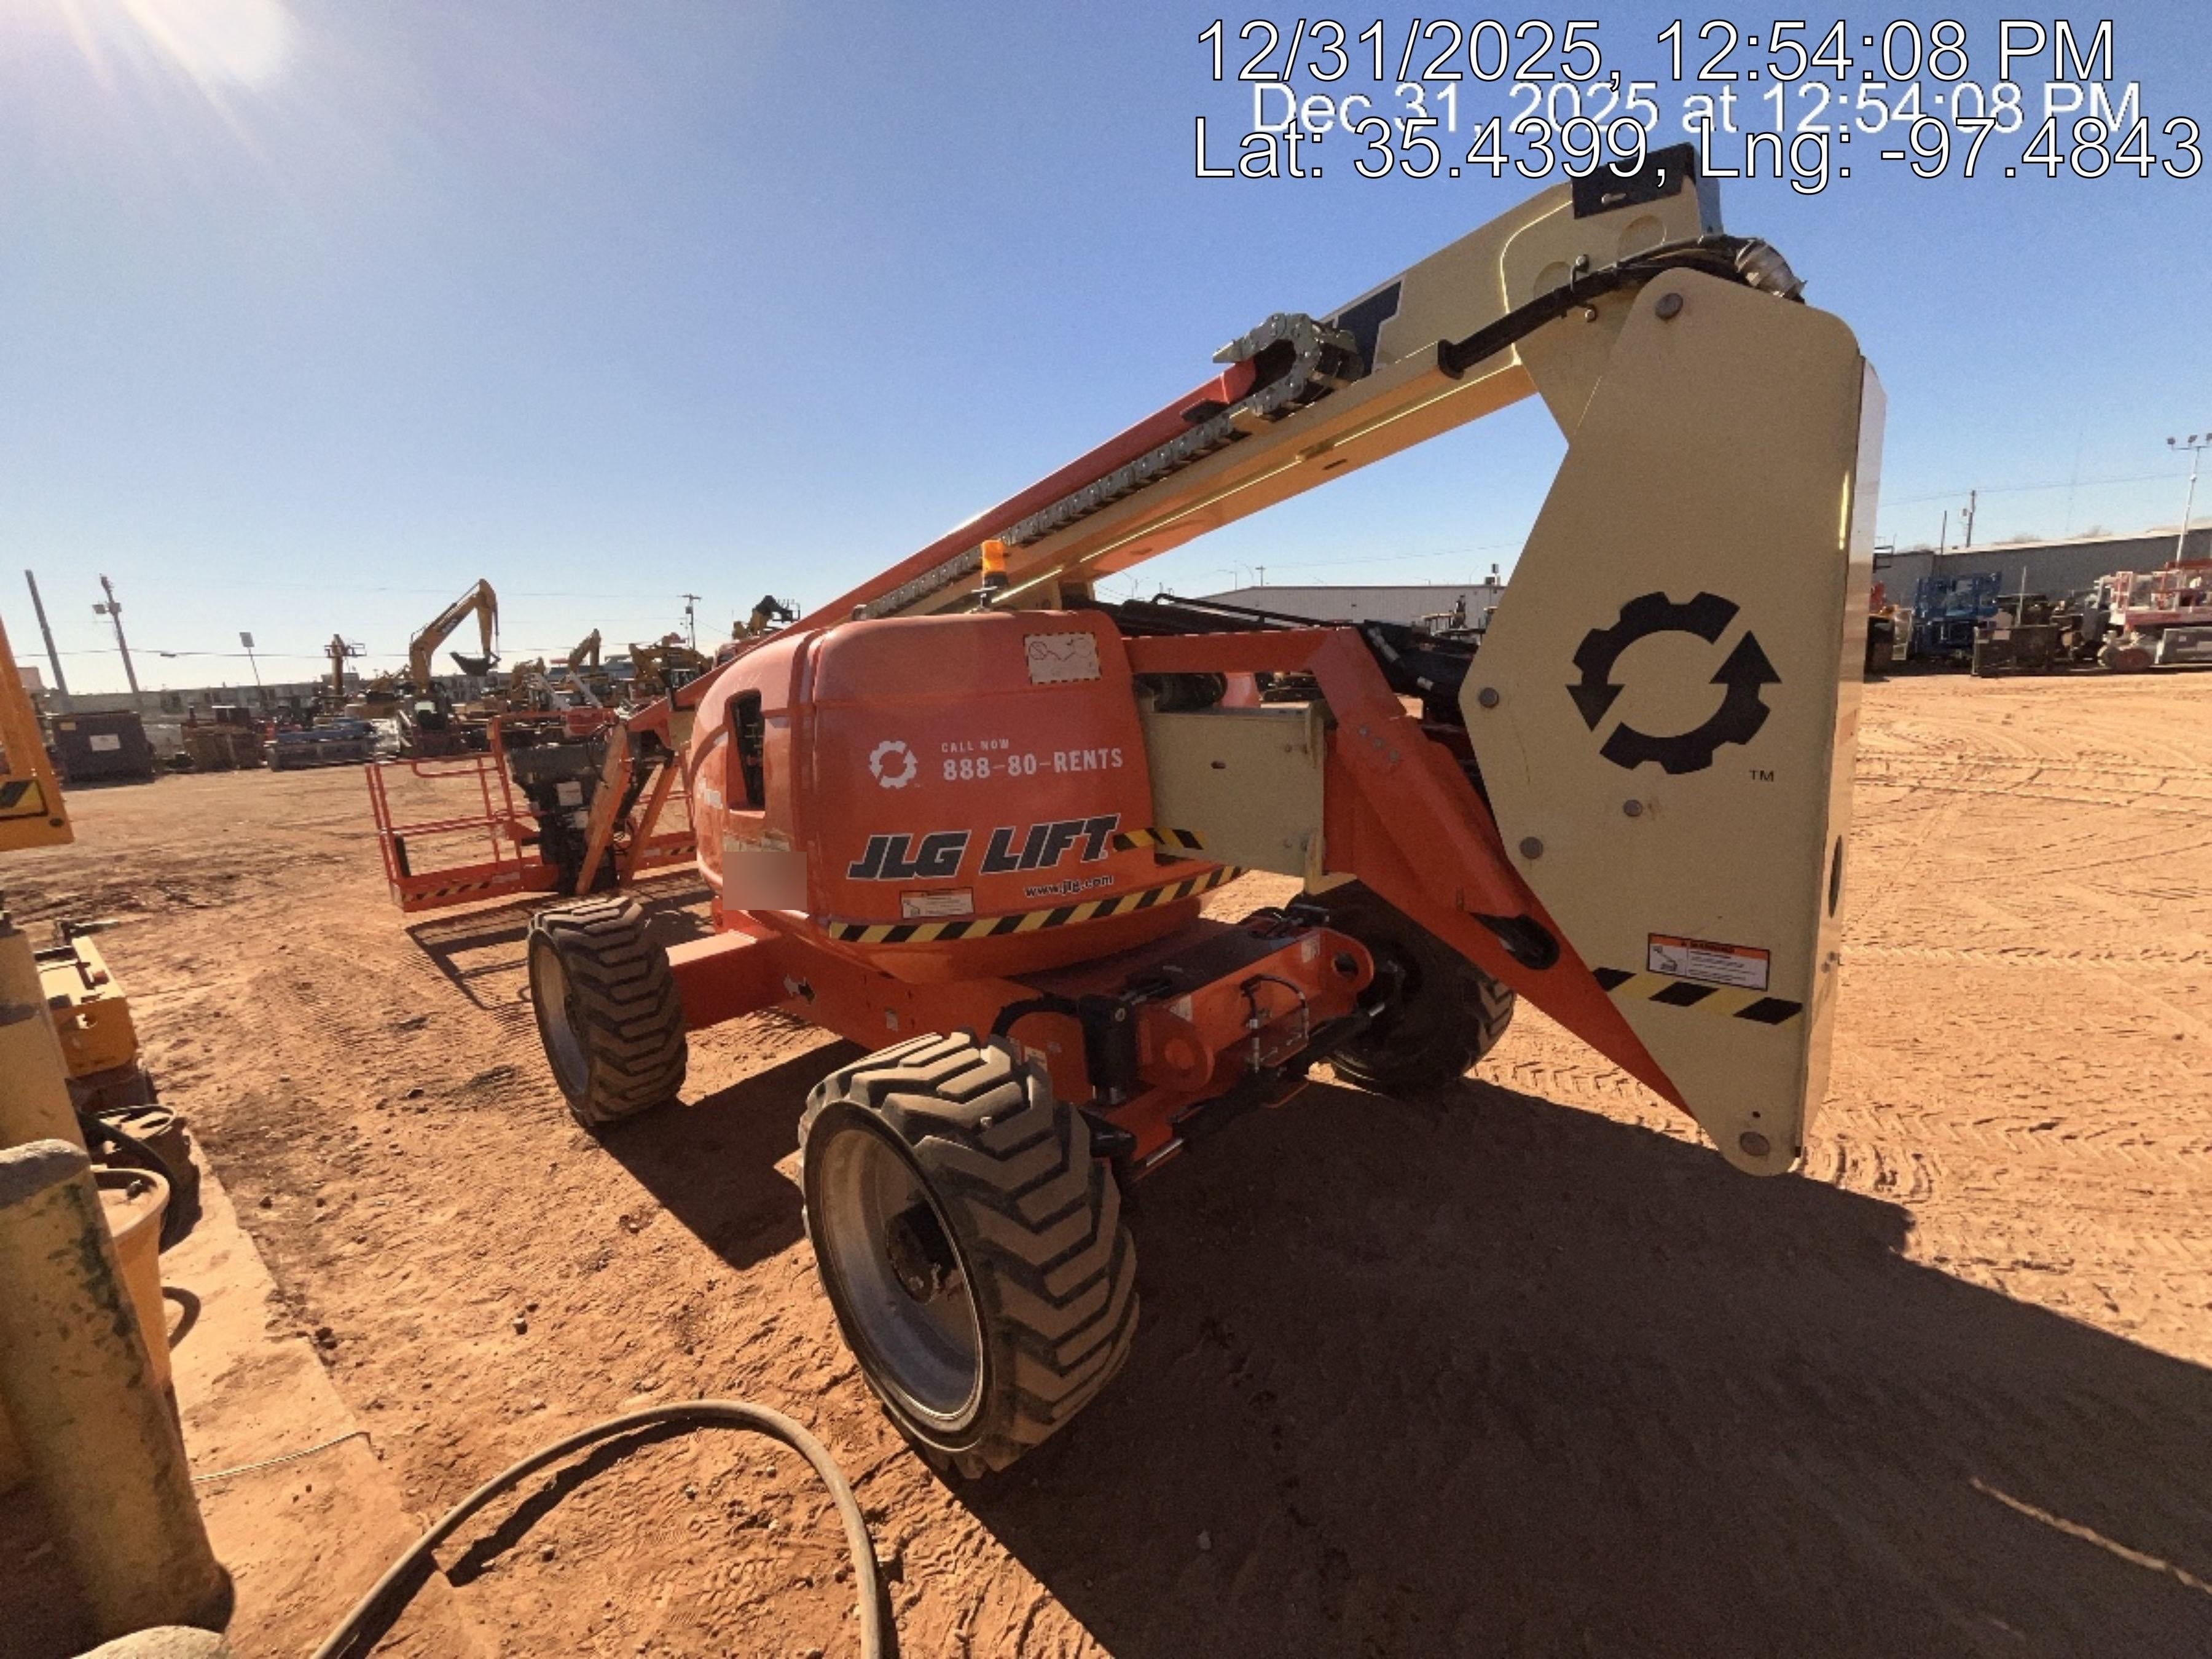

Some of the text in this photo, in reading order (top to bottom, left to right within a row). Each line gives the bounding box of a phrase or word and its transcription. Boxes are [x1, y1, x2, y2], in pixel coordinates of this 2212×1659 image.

[941, 739, 1009, 753] CALL NOW
[943, 748, 1123, 780] 888-80-RENTS
[846, 830, 971, 880] JLG
